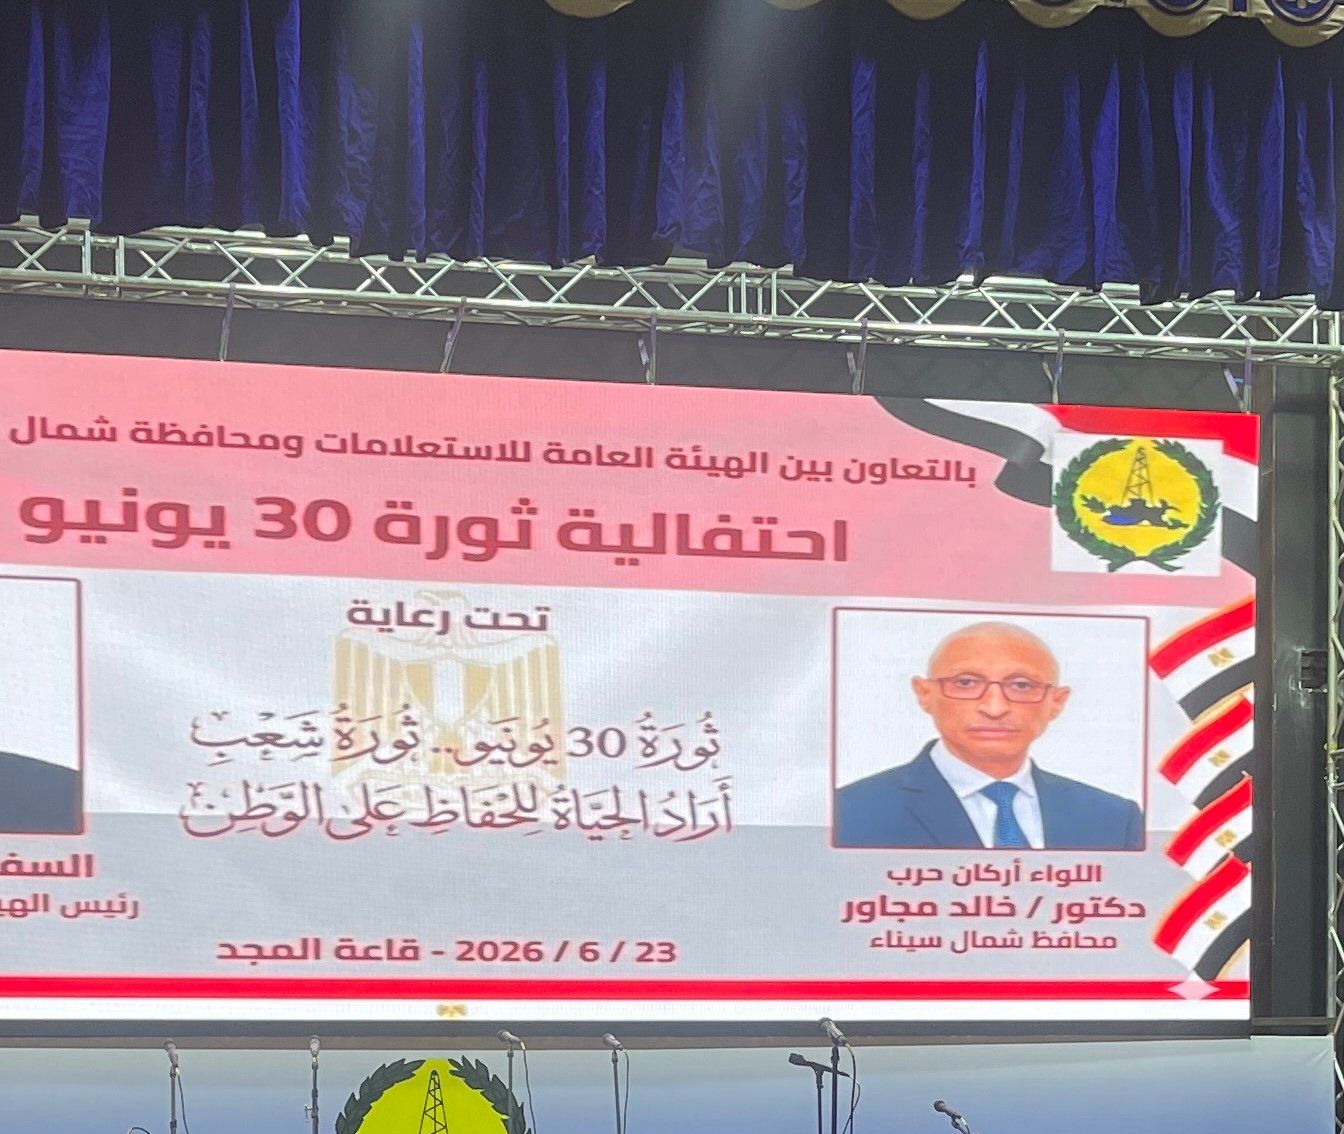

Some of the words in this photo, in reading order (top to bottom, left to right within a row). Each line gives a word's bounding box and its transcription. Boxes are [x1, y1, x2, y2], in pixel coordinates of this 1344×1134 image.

[9, 415, 117, 444] شمال
[129, 420, 304, 458] ومحافظة
[315, 432, 531, 462] للاستعلامات
[543, 441, 653, 468] العامة
[665, 445, 768, 478] الهيئة
[779, 455, 832, 482] بين
[843, 456, 977, 487] بالتعاون
[19, 487, 230, 550] يونيو
[253, 496, 351, 542] 30
[373, 497, 538, 562] ثورة
[557, 508, 848, 566] احتفالية
[347, 598, 451, 635] رعاية
[464, 606, 549, 632] تحت
[567, 726, 626, 758] 30
[886, 867, 942, 886] حرب
[953, 858, 1021, 886] أركان
[1030, 864, 1102, 887] اللواء
[60, 895, 140, 920] رئيس
[841, 894, 937, 923] مجاور
[949, 894, 1016, 918] خالد
[1026, 896, 1044, 919] /
[1051, 896, 1147, 924] دكتور
[216, 937, 321, 966] المجد
[334, 937, 419, 961] قاعة
[455, 940, 543, 962] 2026
[553, 940, 568, 963] /
[578, 941, 600, 963] 6
[610, 941, 626, 963] /
[635, 941, 677, 963] 23
[870, 929, 941, 953] سيناء
[950, 928, 1023, 954] شمال
[1031, 930, 1117, 949] محافظ
